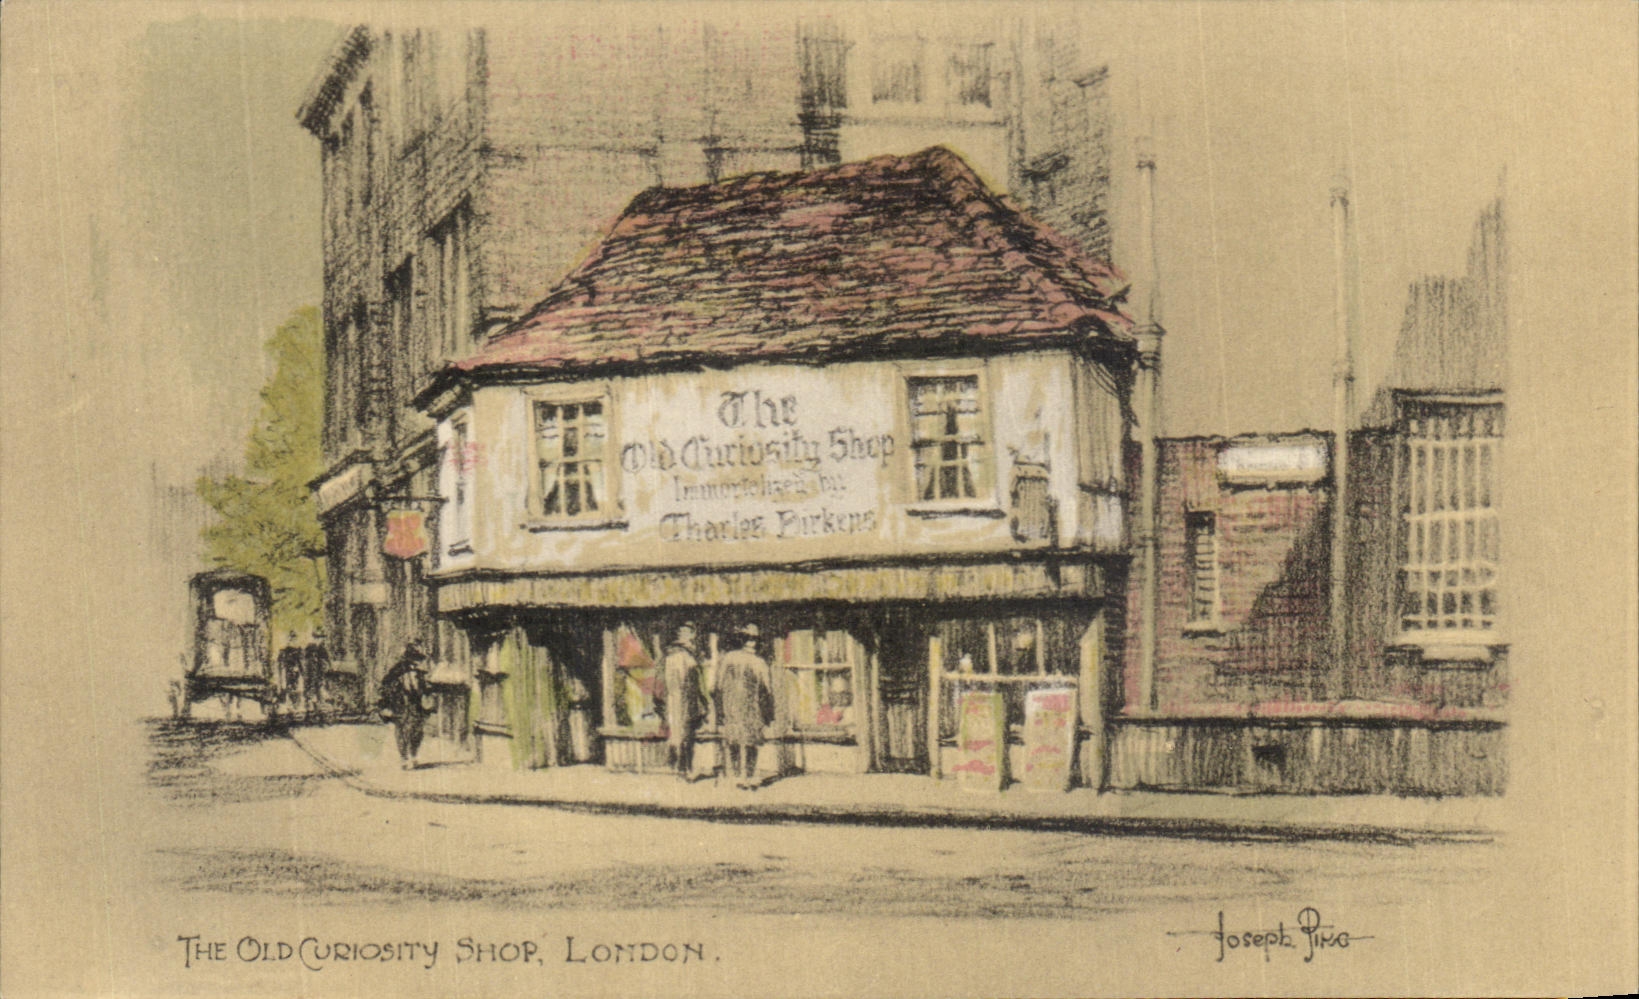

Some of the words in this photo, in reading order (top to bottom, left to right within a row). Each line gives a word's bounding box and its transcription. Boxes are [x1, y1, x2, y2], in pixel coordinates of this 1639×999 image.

[717, 389, 798, 429] The
[620, 439, 676, 474] Old
[680, 430, 821, 472] Curiosity
[828, 425, 896, 469] Shop
